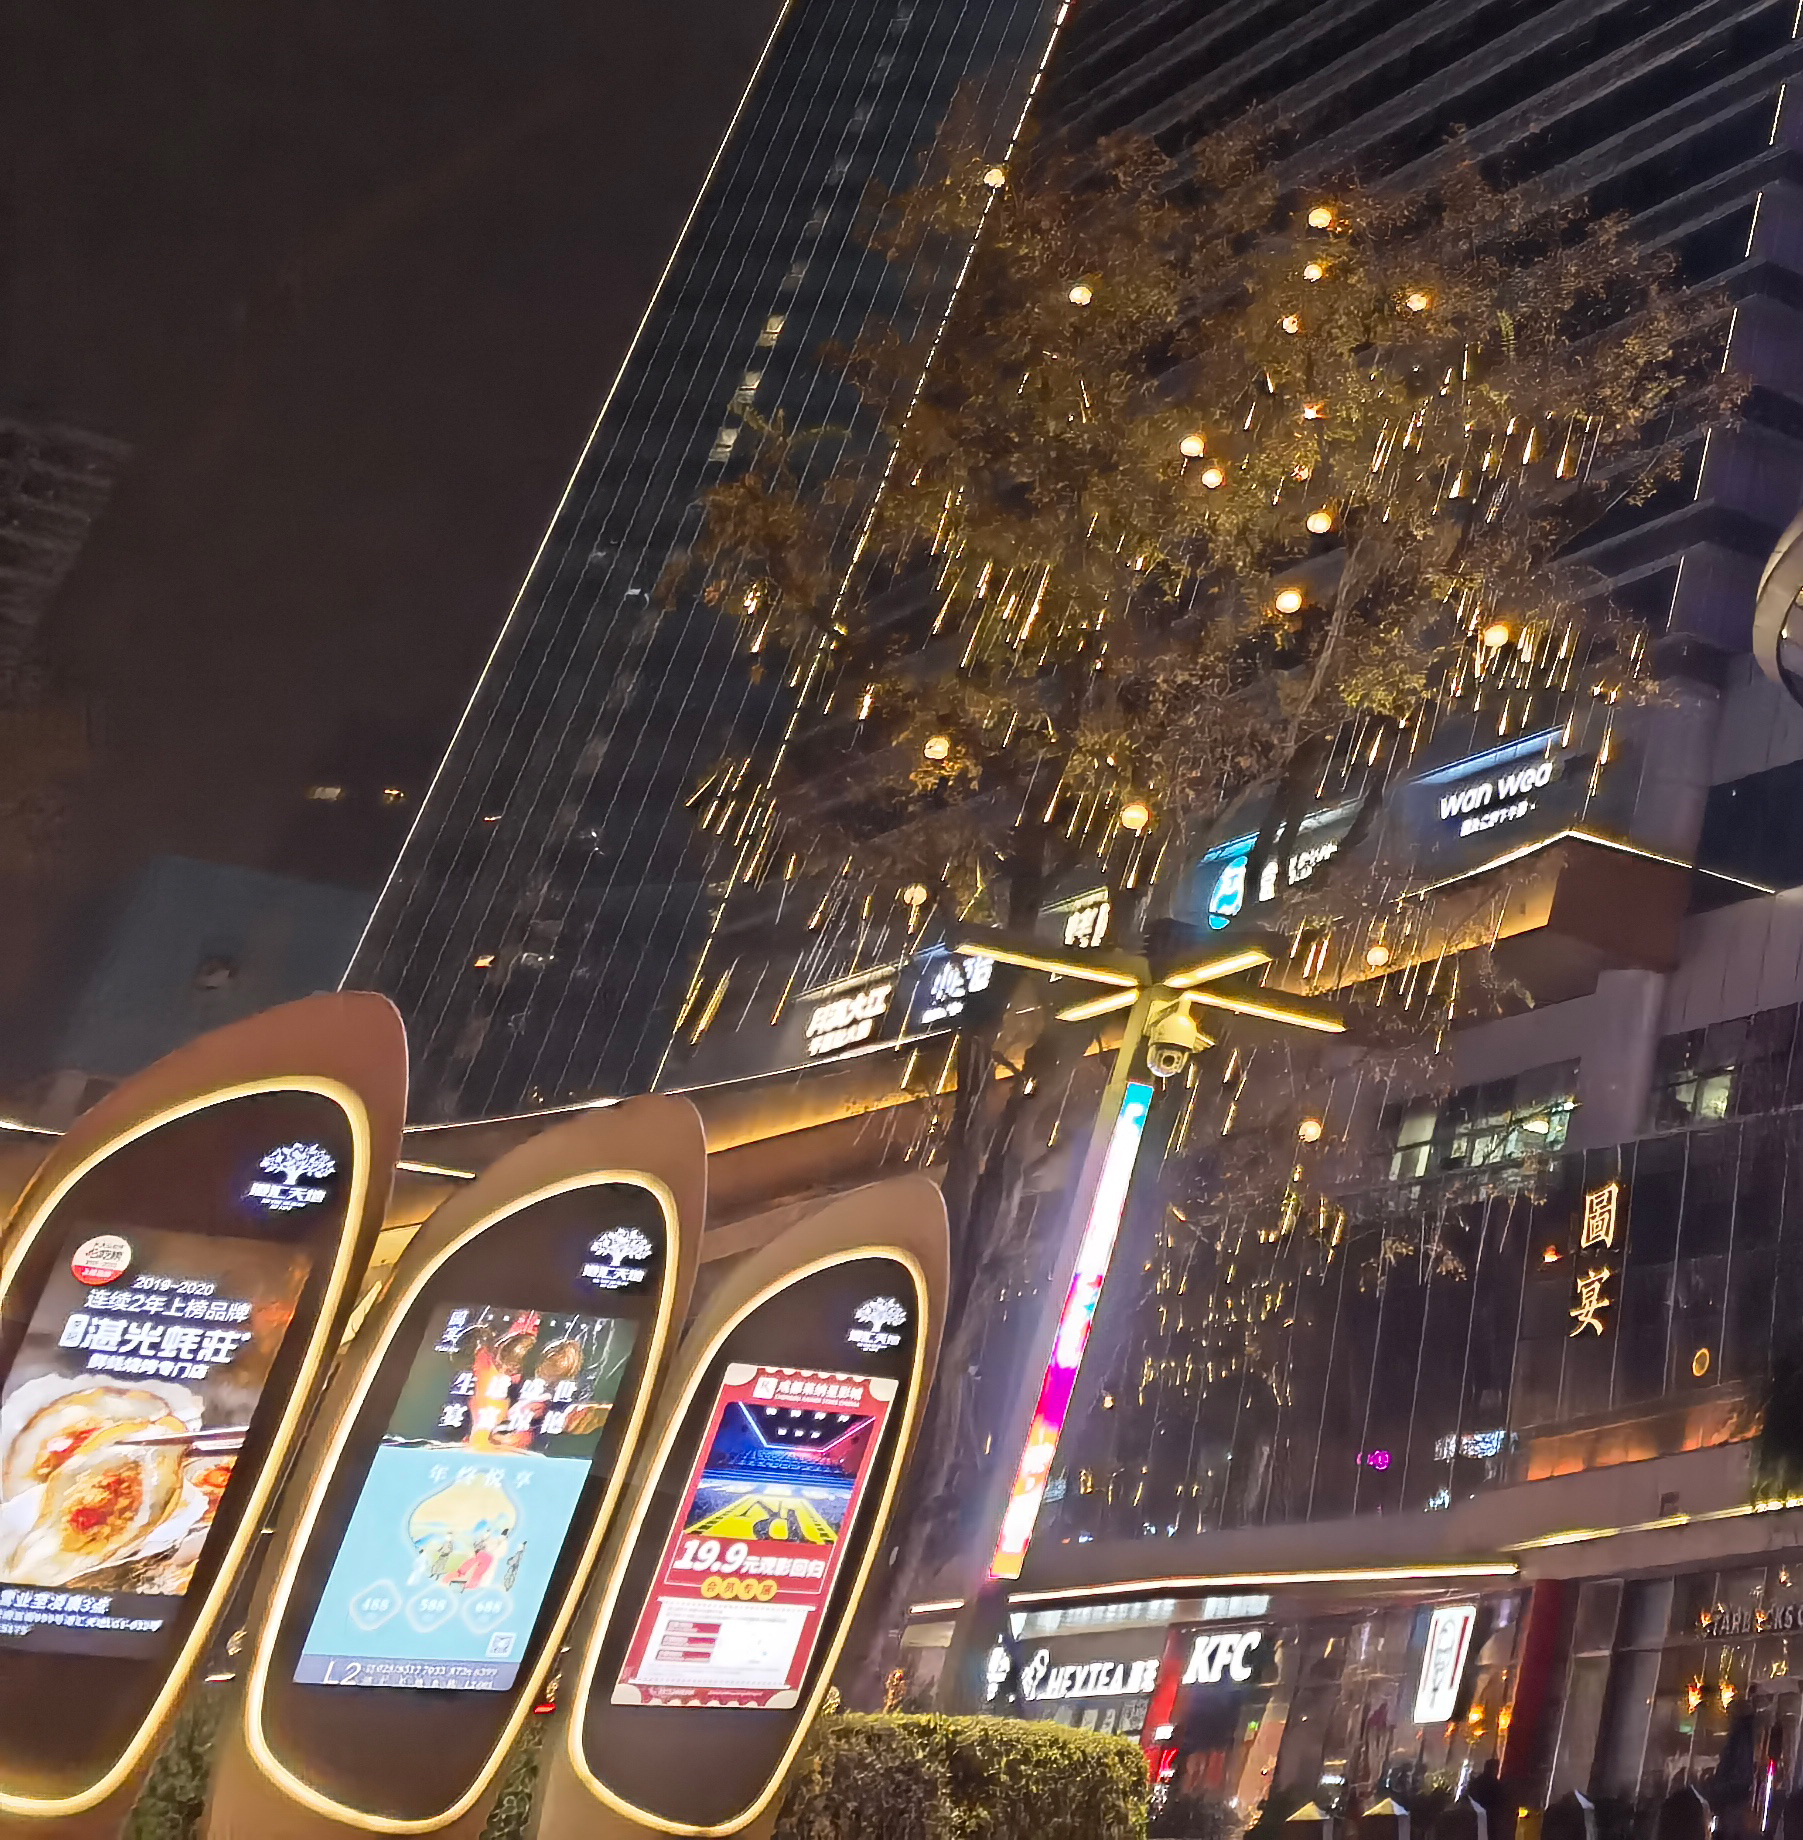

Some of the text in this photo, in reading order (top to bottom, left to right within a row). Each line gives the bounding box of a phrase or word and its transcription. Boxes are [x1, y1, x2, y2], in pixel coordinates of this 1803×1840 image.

[1569, 1182, 1621, 1338] 圖宴
[84, 1289, 252, 1323] 连续2年上榜品牌
[323, 1660, 362, 1686] L2
[1182, 1631, 1263, 1685] KFC
[1048, 1662, 1126, 1699] HEYTEA
